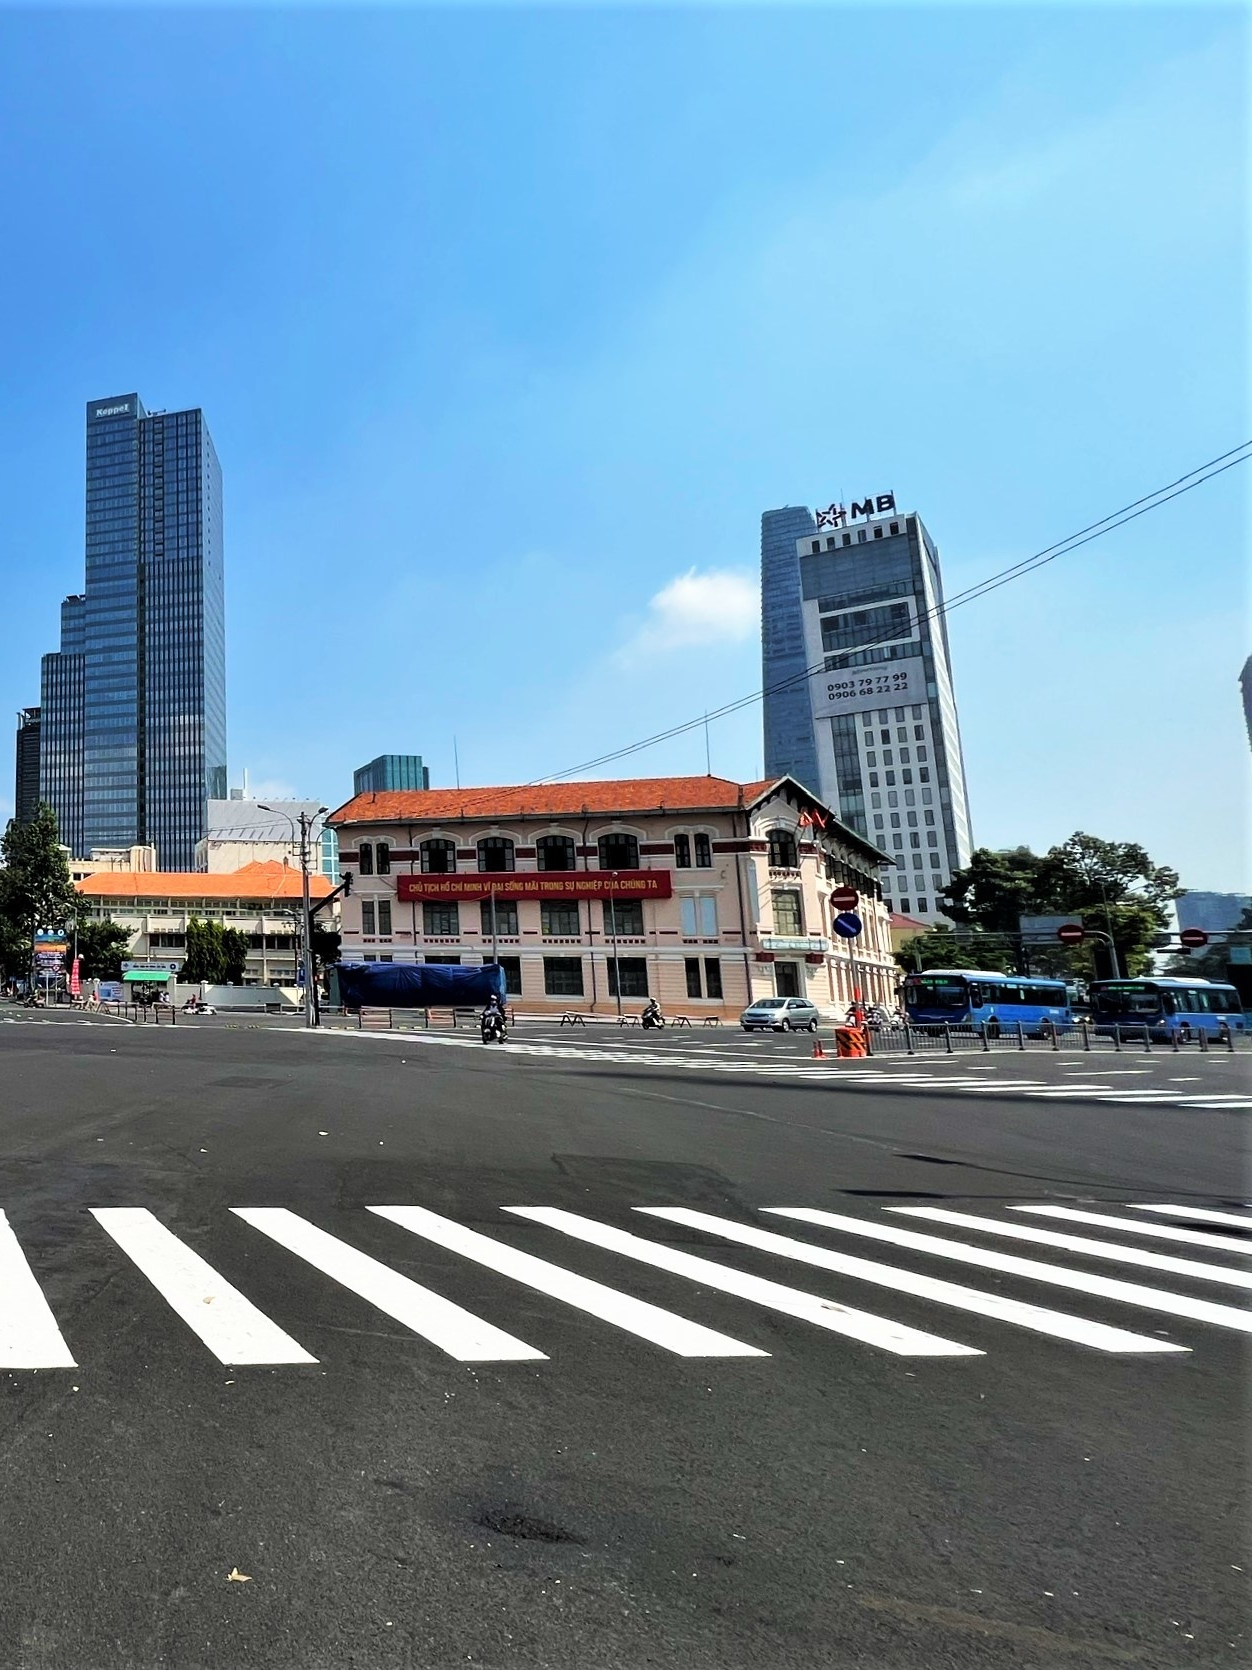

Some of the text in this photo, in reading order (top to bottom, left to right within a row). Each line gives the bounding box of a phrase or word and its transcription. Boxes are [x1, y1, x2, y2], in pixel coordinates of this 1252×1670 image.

[96, 404, 129, 417] Keppel
[851, 495, 895, 519] MB
[827, 672, 907, 692] 0903 79 77 99
[828, 682, 908, 701] 0906 68 22 22
[409, 881, 422, 893] CHỦ
[424, 883, 439, 893] TỊCH
[440, 881, 450, 892] HỒ
[451, 881, 463, 892] CHÍ
[464, 882, 482, 892] MINH
[505, 880, 523, 892] SỐNG
[525, 880, 539, 891] MÃI
[540, 881, 564, 891] TRONG
[576, 880, 602, 891] NGHIỆP
[620, 878, 646, 890] CHÚNG
[648, 880, 658, 889] TA
